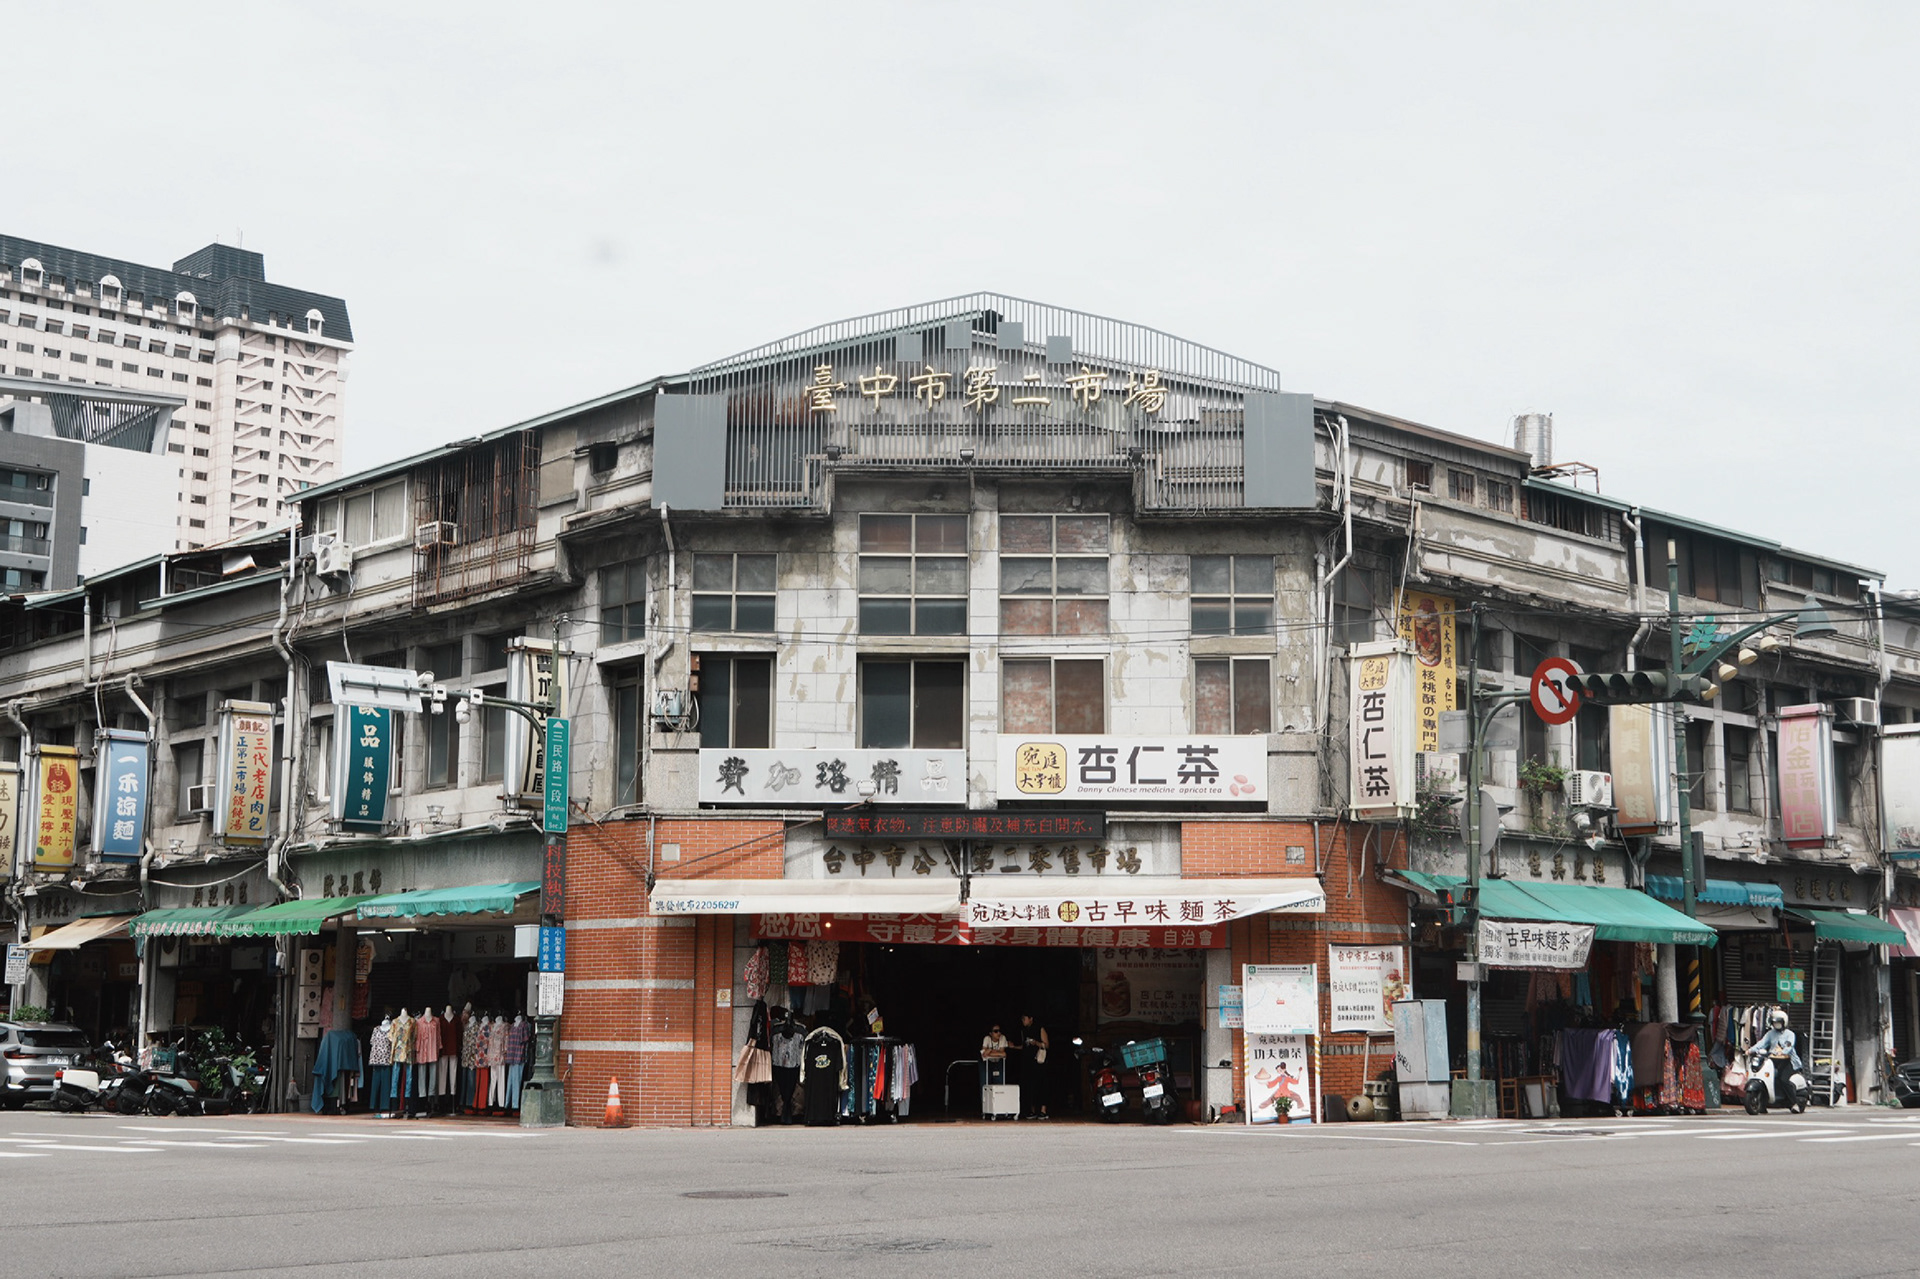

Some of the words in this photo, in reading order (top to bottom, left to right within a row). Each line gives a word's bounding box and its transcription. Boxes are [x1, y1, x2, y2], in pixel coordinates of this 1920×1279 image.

[804, 363, 1171, 414] 臺中市第二市場
[1362, 691, 1390, 797] 杏仁茶
[551, 731, 564, 803] 三民路二段
[1078, 744, 1220, 785] 杏仁茶
[1020, 773, 1062, 789] 大掌櫃
[1077, 786, 1103, 794] Danny
[1106, 785, 1138, 794] Chinese
[1138, 785, 1176, 794] medicine
[1178, 786, 1207, 794] apricot
[1209, 786, 1222, 794] tea
[546, 804, 566, 813] Sanmin
[544, 844, 563, 913] 科技執法
[1084, 899, 1238, 922] 古早味麵茶
[866, 923, 1151, 945] 守護大家身體健康
[1163, 928, 1212, 946] 自治會
[1505, 927, 1570, 951] 古早味麵茶
[1337, 950, 1394, 963] 台中市第二市場
